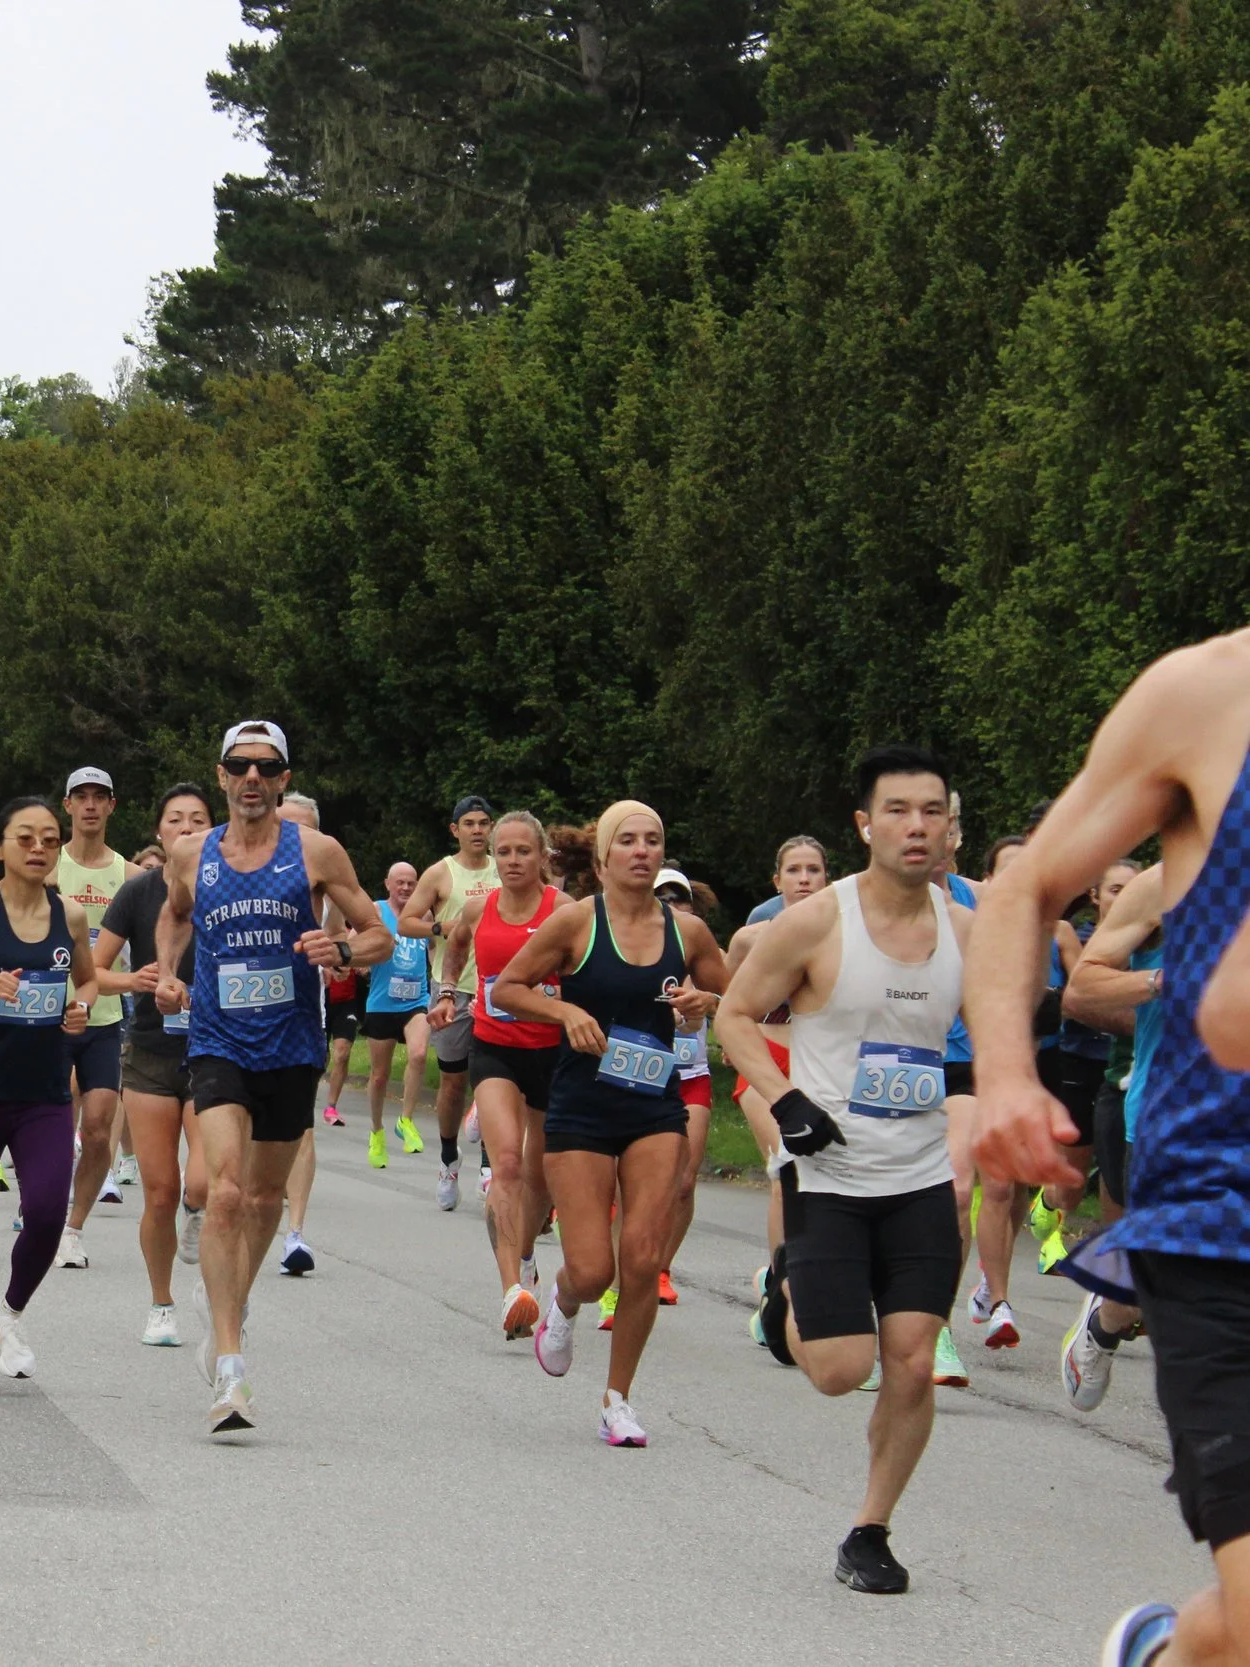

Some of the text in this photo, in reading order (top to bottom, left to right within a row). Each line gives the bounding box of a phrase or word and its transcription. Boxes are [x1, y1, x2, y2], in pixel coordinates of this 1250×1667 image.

[205, 899, 299, 931] STRAWBERRY
[227, 929, 282, 948] CANYON
[226, 974, 287, 1004] 228
[394, 984, 416, 998] 421
[893, 990, 929, 1001] BANDIT
[610, 1045, 665, 1081] 510
[860, 1067, 938, 1107] 360
